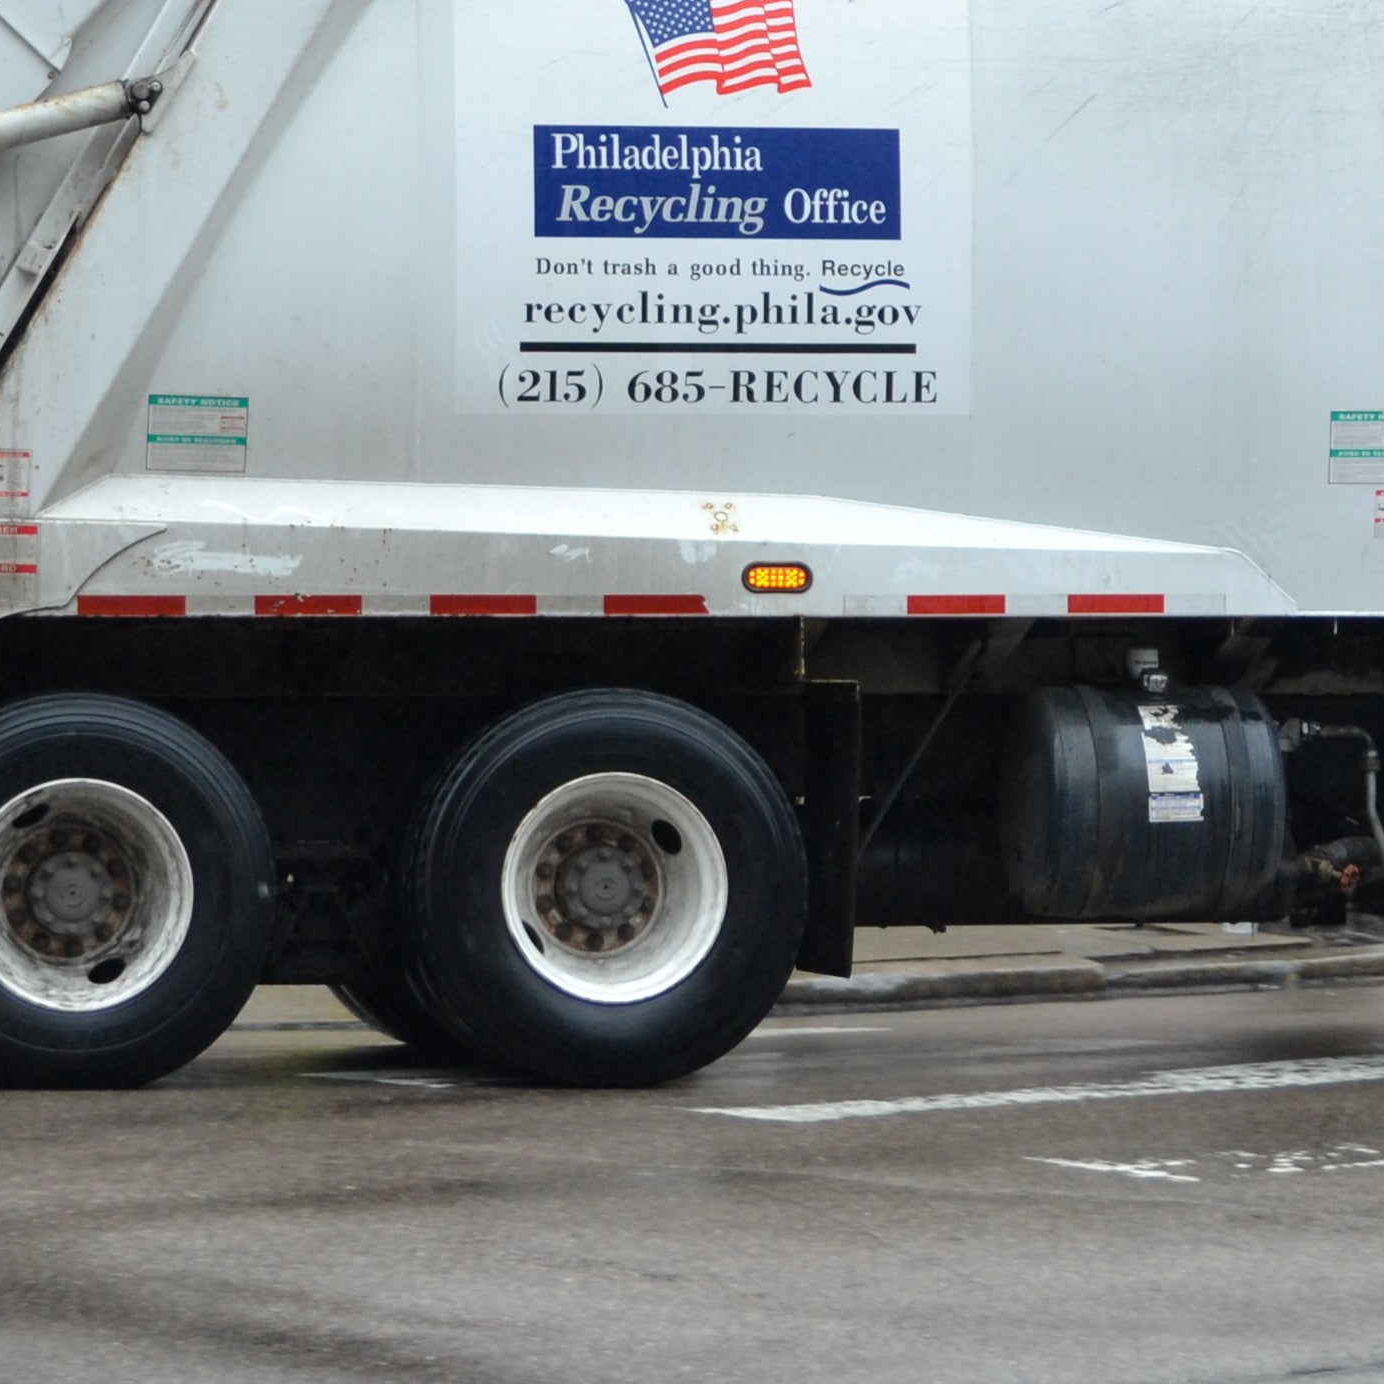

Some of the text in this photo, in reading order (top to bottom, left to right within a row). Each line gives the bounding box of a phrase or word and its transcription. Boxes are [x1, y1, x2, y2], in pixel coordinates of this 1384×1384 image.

[551, 133, 763, 178] Philadelphia
[556, 184, 887, 235] Recycling Office
[536, 257, 905, 281] Don't trash a good thing. Recycle
[524, 290, 922, 336] recycling.phila.gov
[158, 397, 239, 407] SAFETY NOTICE
[498, 363, 938, 409] (215) 685-RECYCLE
[1339, 413, 1375, 421] SAFETY
